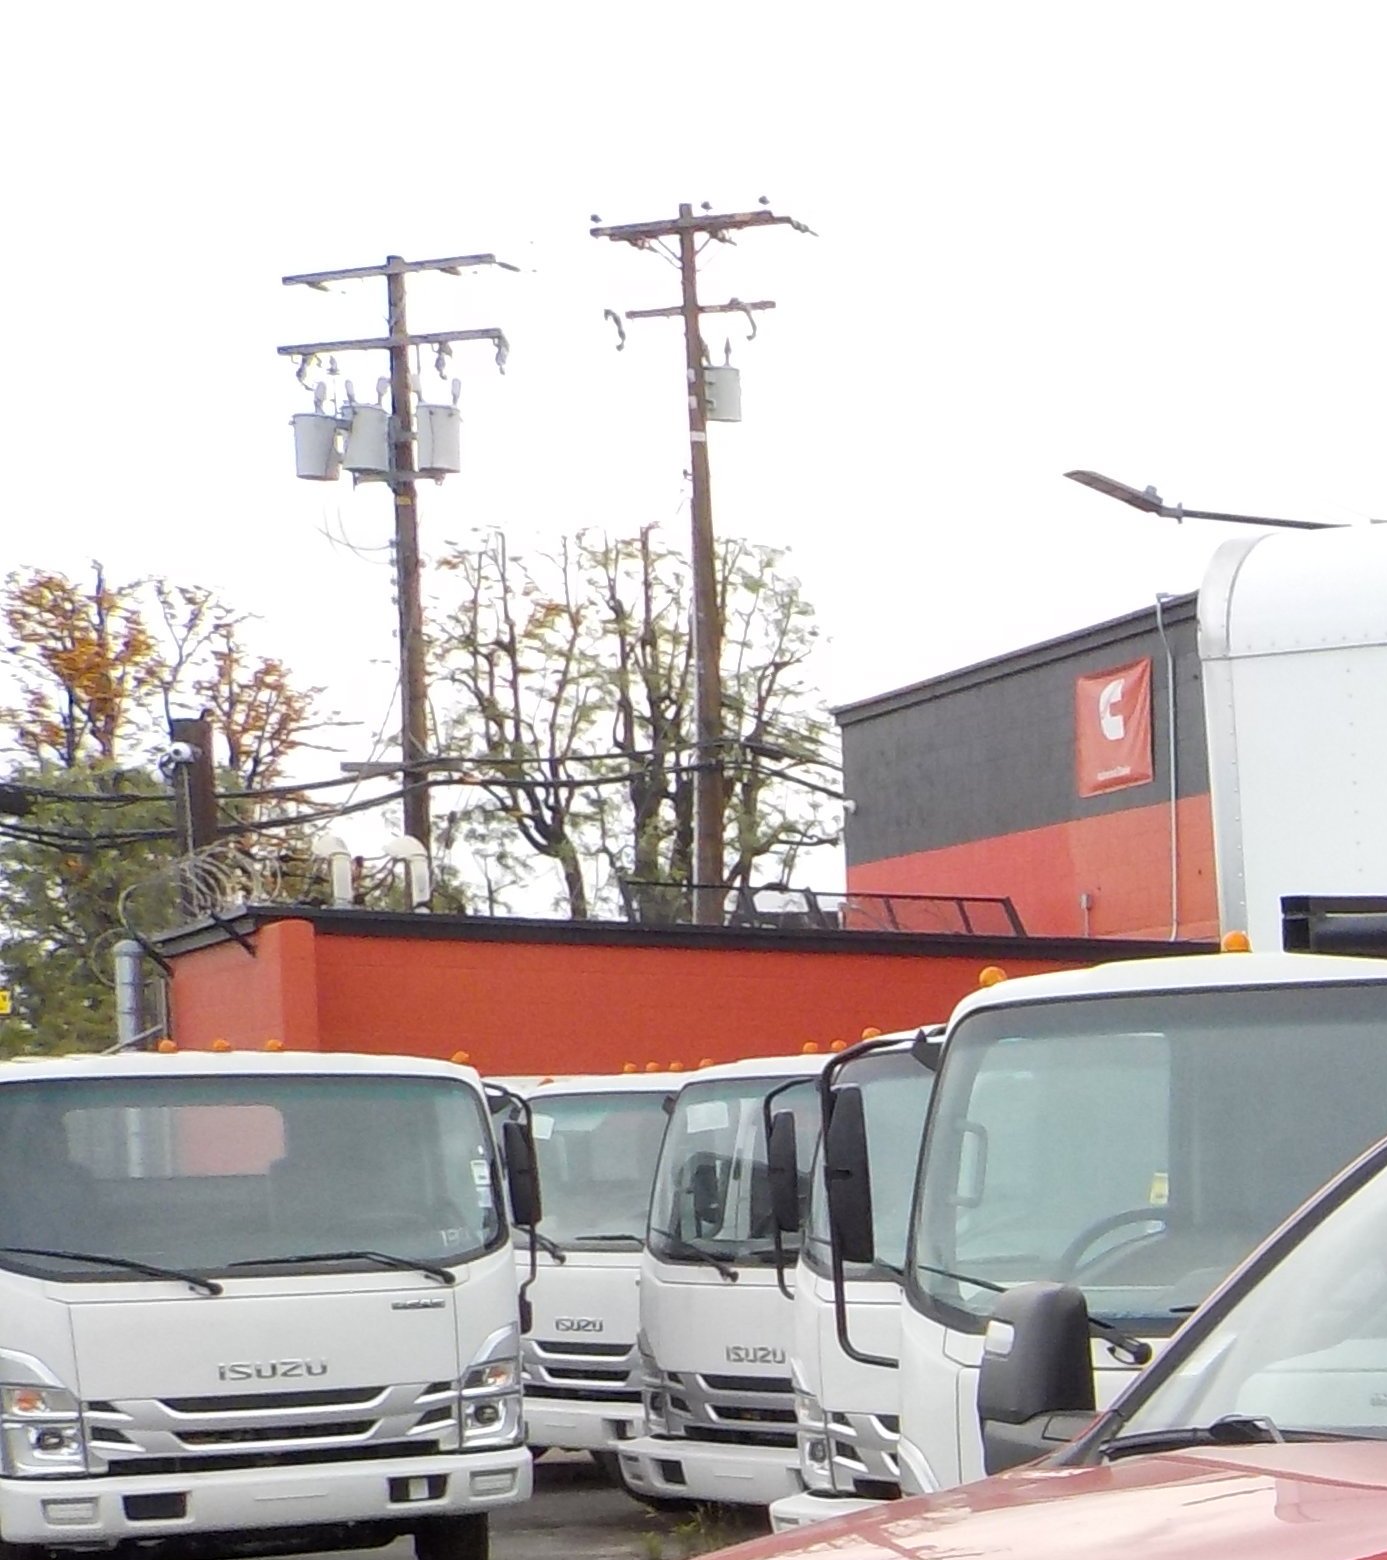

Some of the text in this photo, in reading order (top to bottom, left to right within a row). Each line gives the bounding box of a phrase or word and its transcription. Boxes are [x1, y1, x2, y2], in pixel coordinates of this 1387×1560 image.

[555, 1318, 603, 1332] ISUZU
[725, 1345, 786, 1364] ISUZU
[218, 1360, 327, 1381] ISUZU
